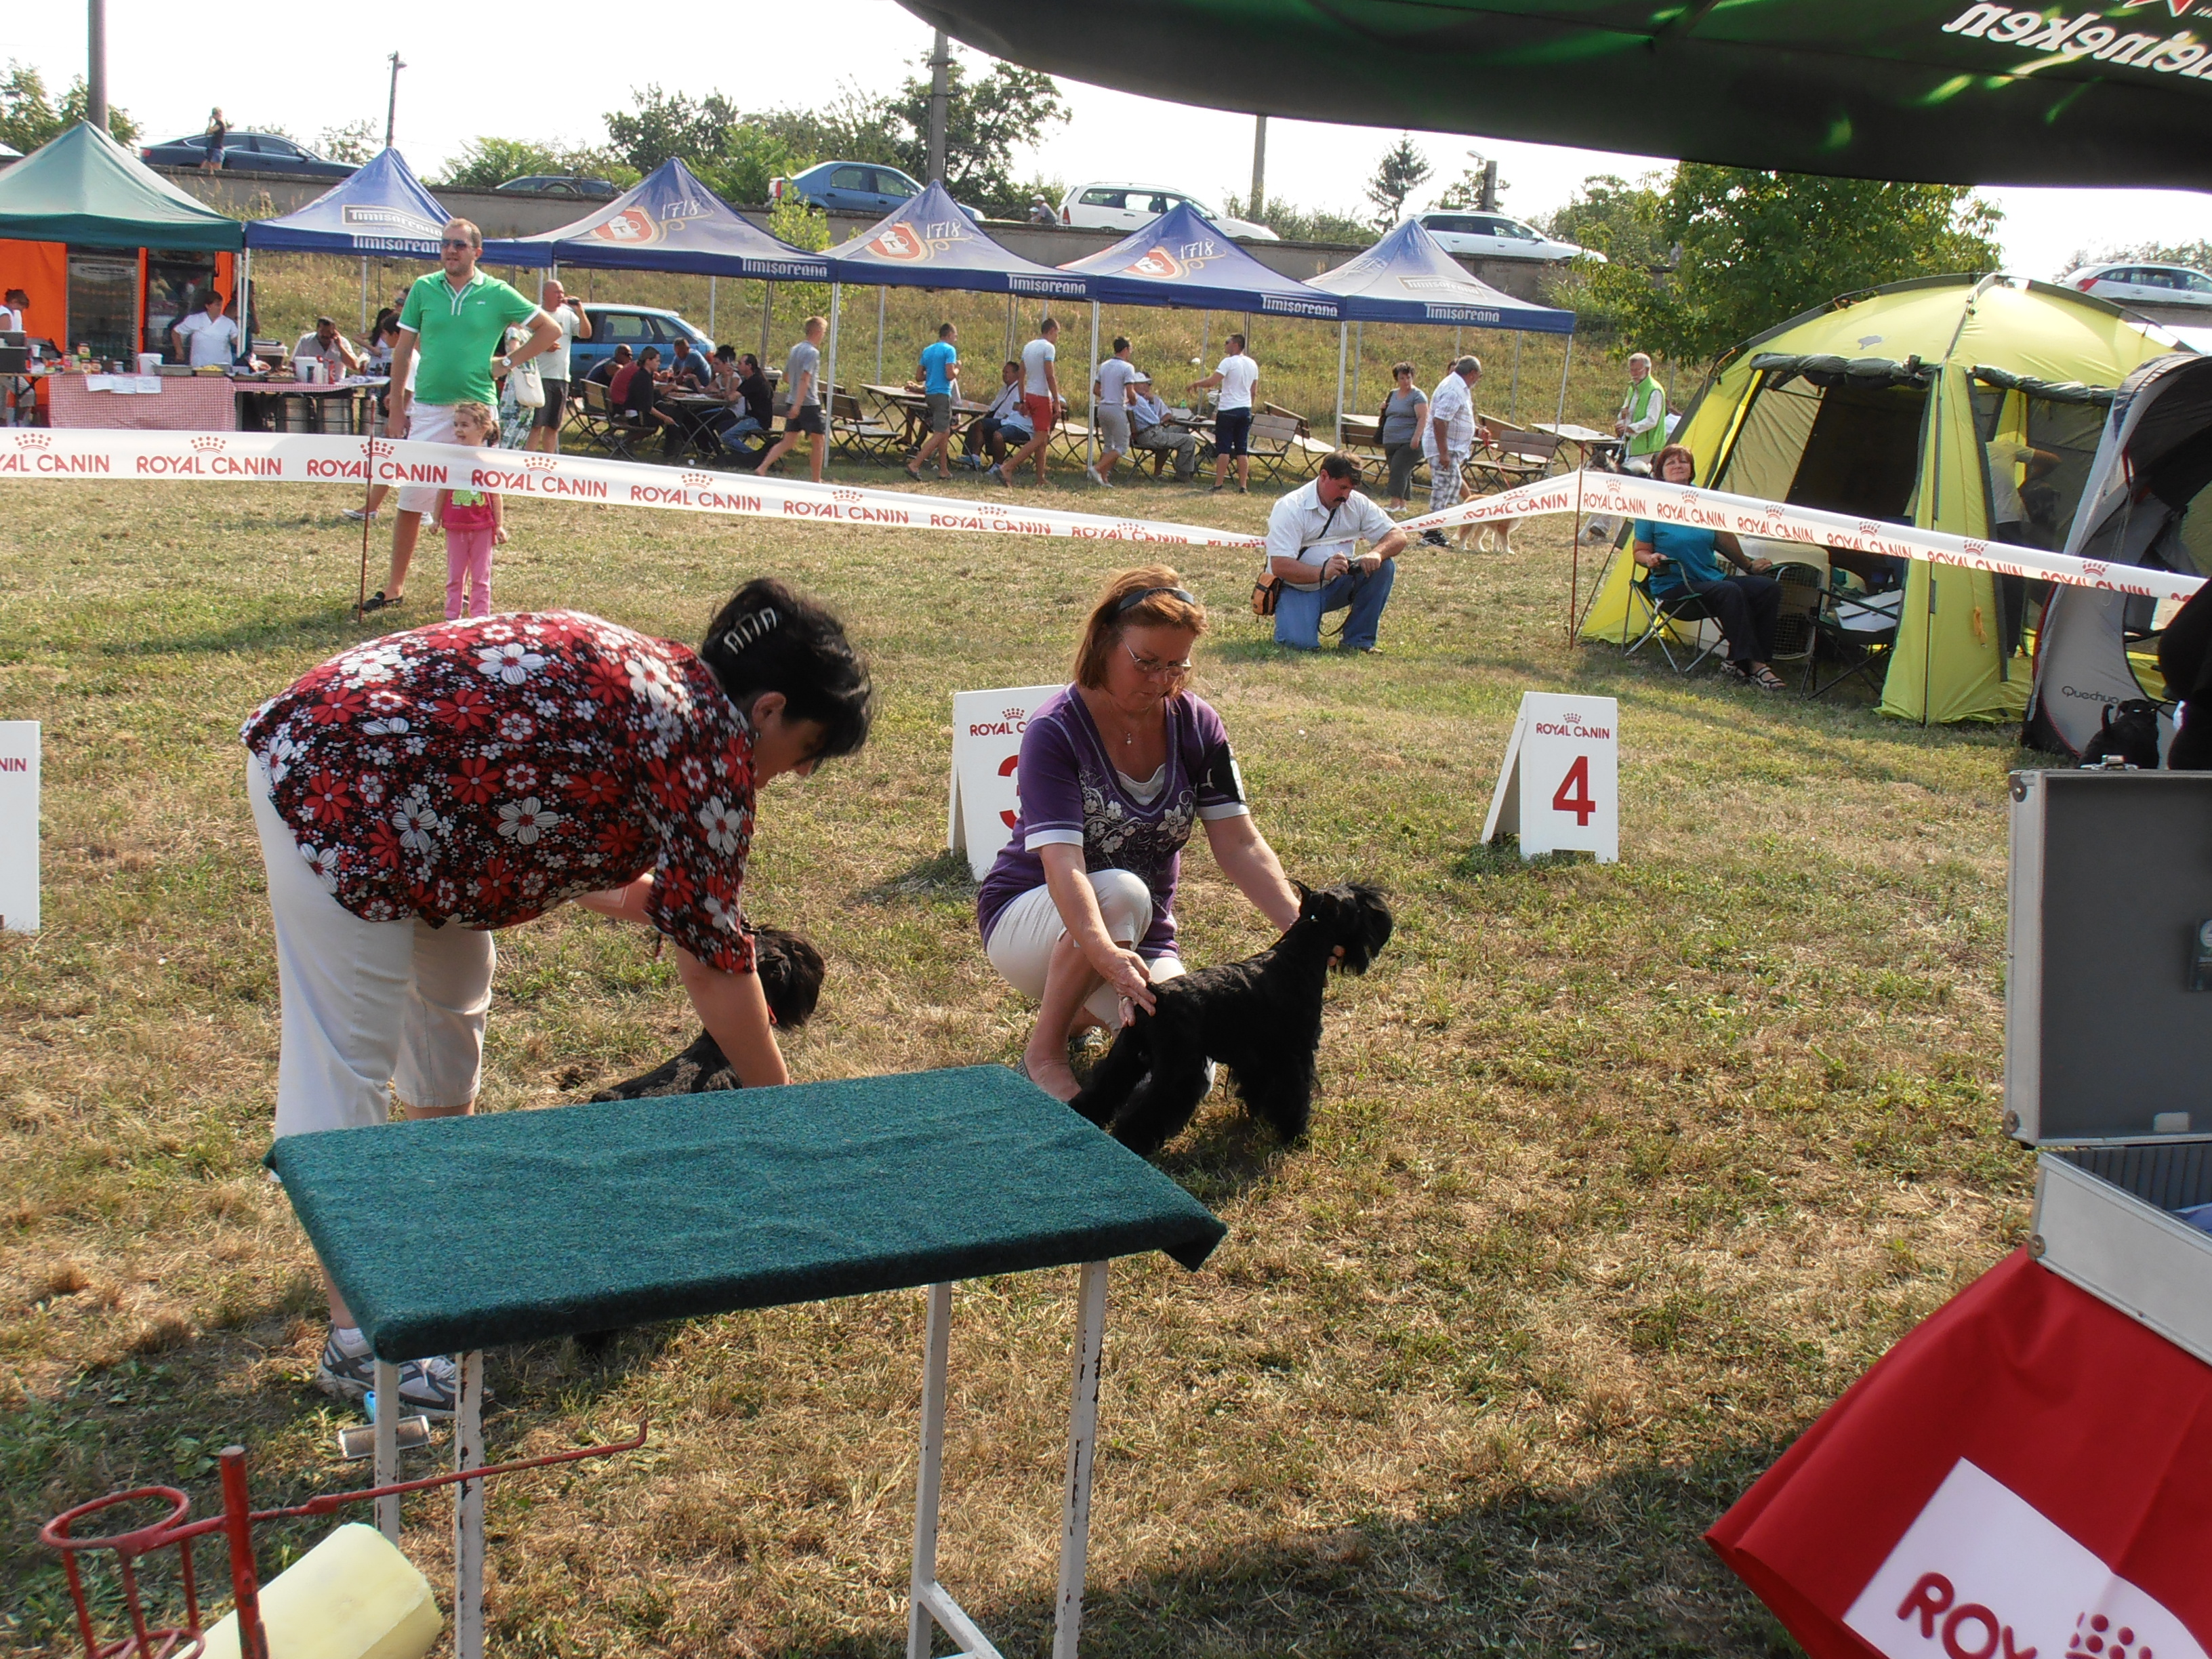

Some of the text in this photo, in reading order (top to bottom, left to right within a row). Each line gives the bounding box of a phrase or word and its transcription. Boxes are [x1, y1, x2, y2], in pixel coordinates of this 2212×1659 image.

[661, 198, 701, 220] 1718
[926, 218, 961, 239] 1718
[1181, 239, 1214, 259] 1718
[37, 454, 109, 473] CANIN
[136, 455, 282, 476] ROYAL CANIN
[379, 462, 447, 483] CANIN
[471, 469, 607, 498] ROYAL CANIN
[630, 485, 761, 512] ROYAL CANIN
[1516, 493, 1568, 512] CANIN
[1583, 493, 1646, 515] ROYAL CANIN
[783, 500, 909, 525] ROYAL CANIN
[1657, 503, 1727, 528] ROYAL CANIN
[930, 514, 1051, 535] ROYAL CANIN
[1071, 526, 1187, 544] ROYAL CANIN
[1738, 516, 1816, 543] ROYAL CANIN
[2062, 685, 2119, 704] Quechua
[970, 722, 1014, 737] ROYAL
[1536, 722, 1610, 739] ROYAL CANIN
[1553, 755, 1596, 827] 4
